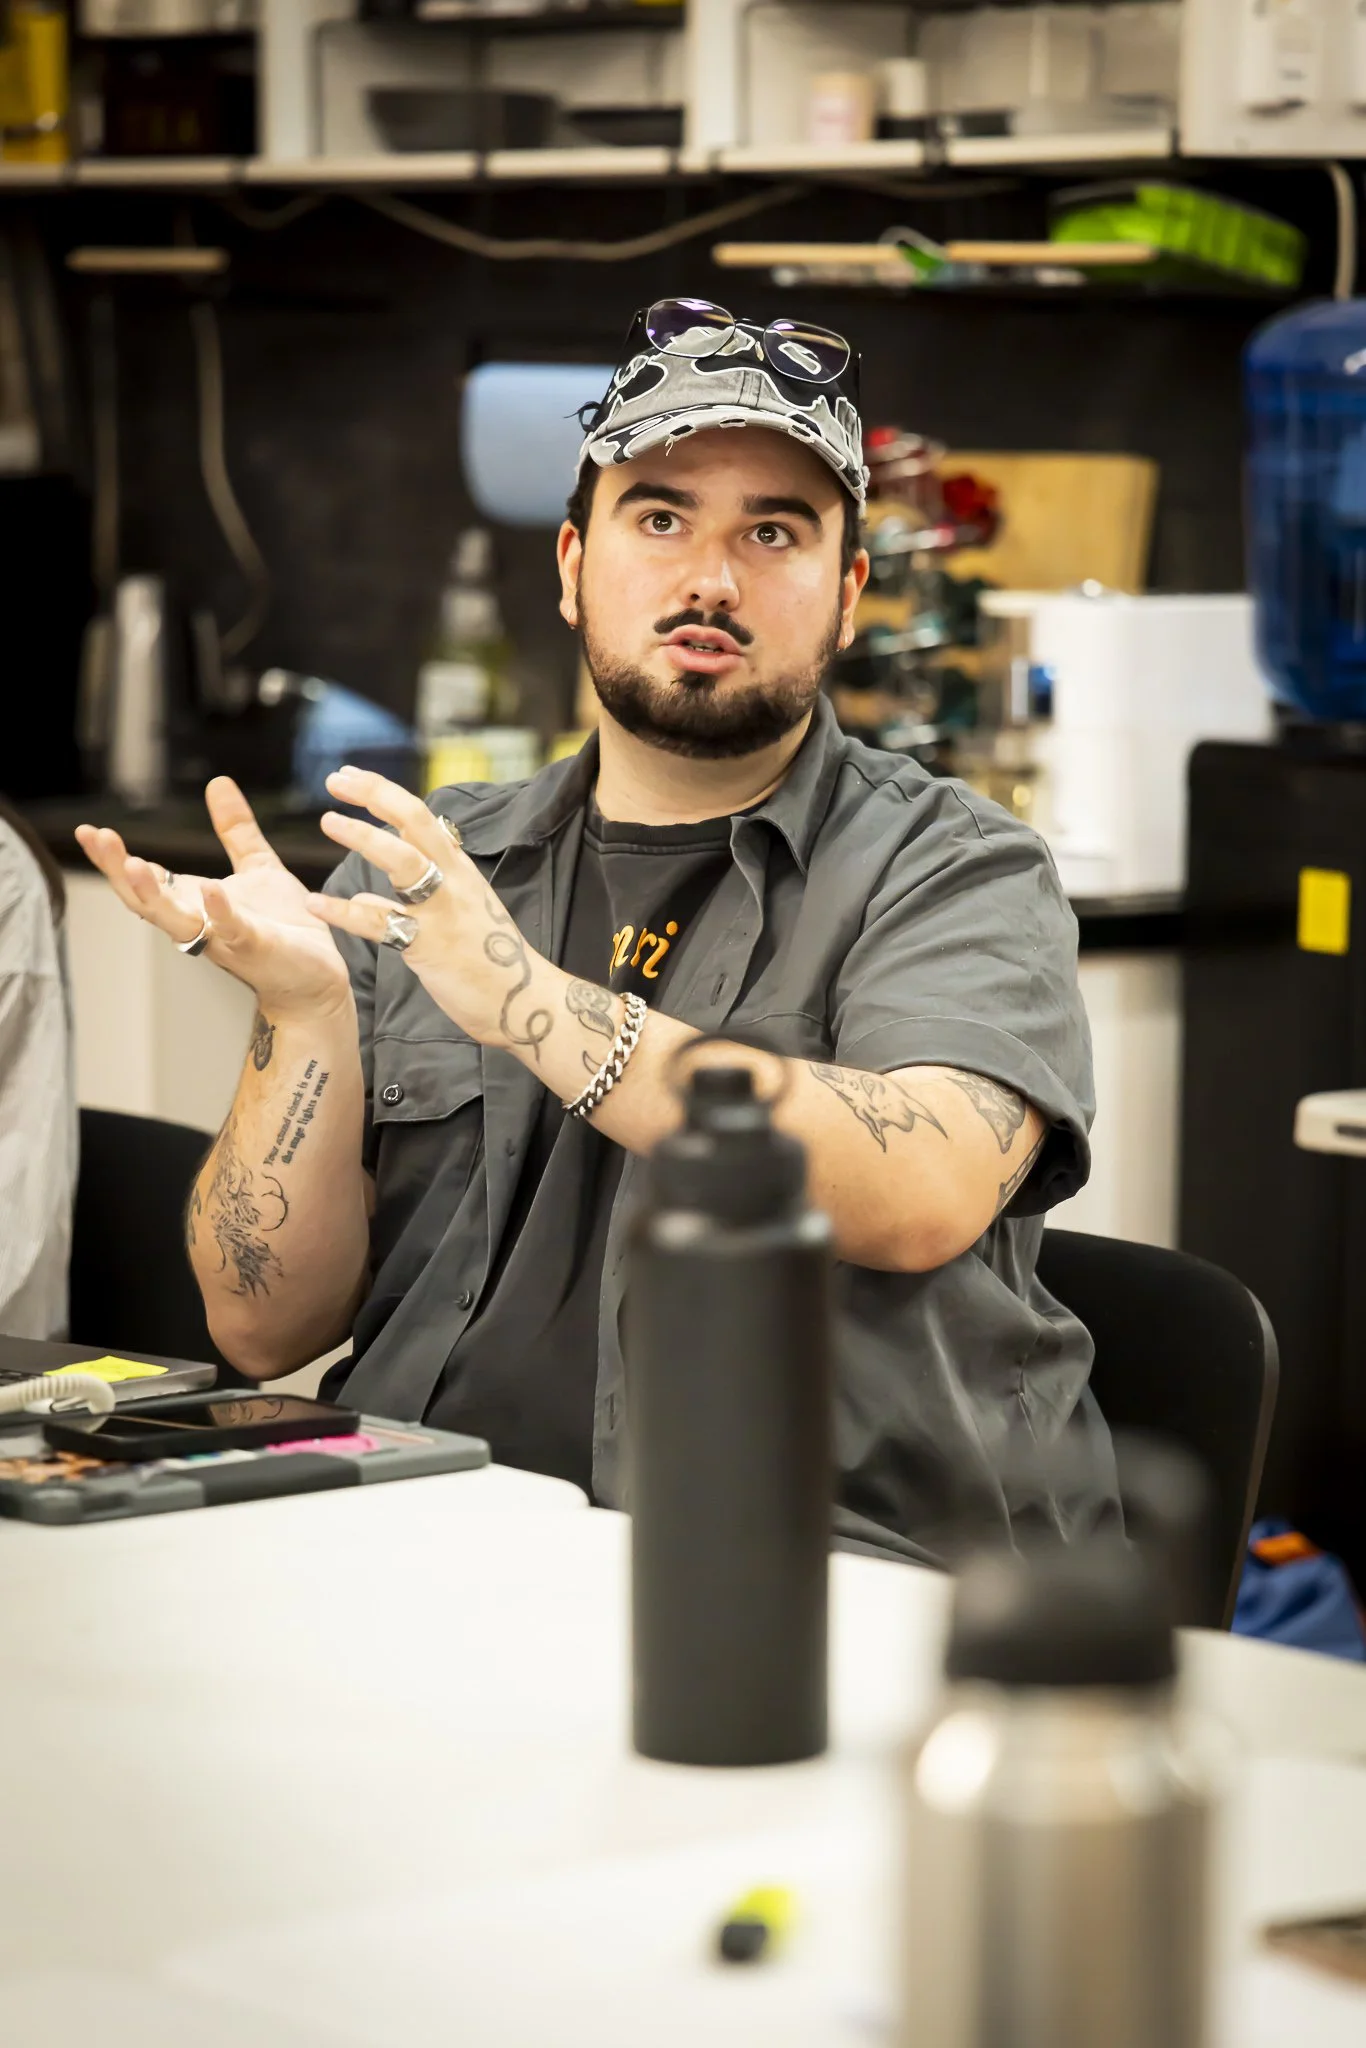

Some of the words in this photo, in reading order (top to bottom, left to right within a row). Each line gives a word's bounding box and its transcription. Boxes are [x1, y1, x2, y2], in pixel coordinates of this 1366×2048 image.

[263, 1146, 279, 1166] Your
[287, 1091, 304, 1117] check
[297, 1081, 308, 1089] is
[304, 1059, 318, 1079] over
[297, 1100, 317, 1125] lights
